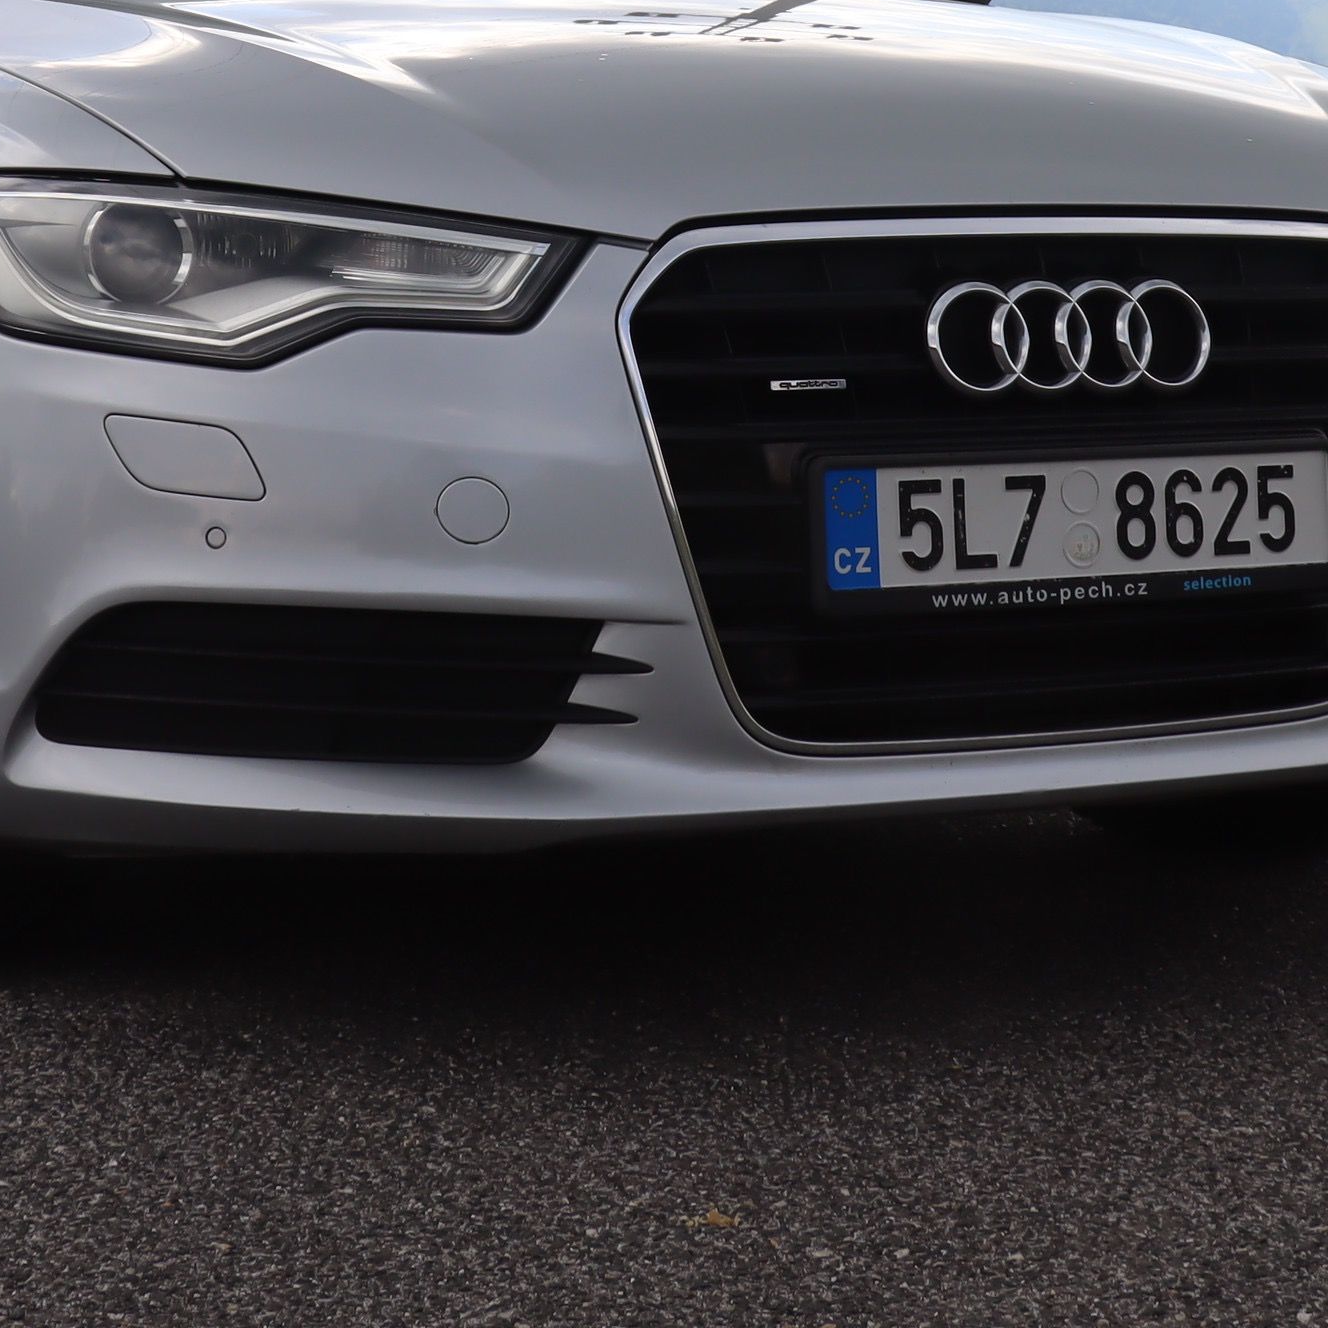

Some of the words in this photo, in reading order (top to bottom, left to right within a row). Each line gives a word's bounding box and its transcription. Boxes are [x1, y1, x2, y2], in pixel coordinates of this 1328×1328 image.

[779, 380, 838, 390] quattro
[898, 474, 1047, 572] 5L7
[1115, 464, 1296, 561] 8625
[834, 547, 872, 574] CZ
[931, 581, 1148, 608] www.auto-pech.cz
[1183, 575, 1252, 591] selection
